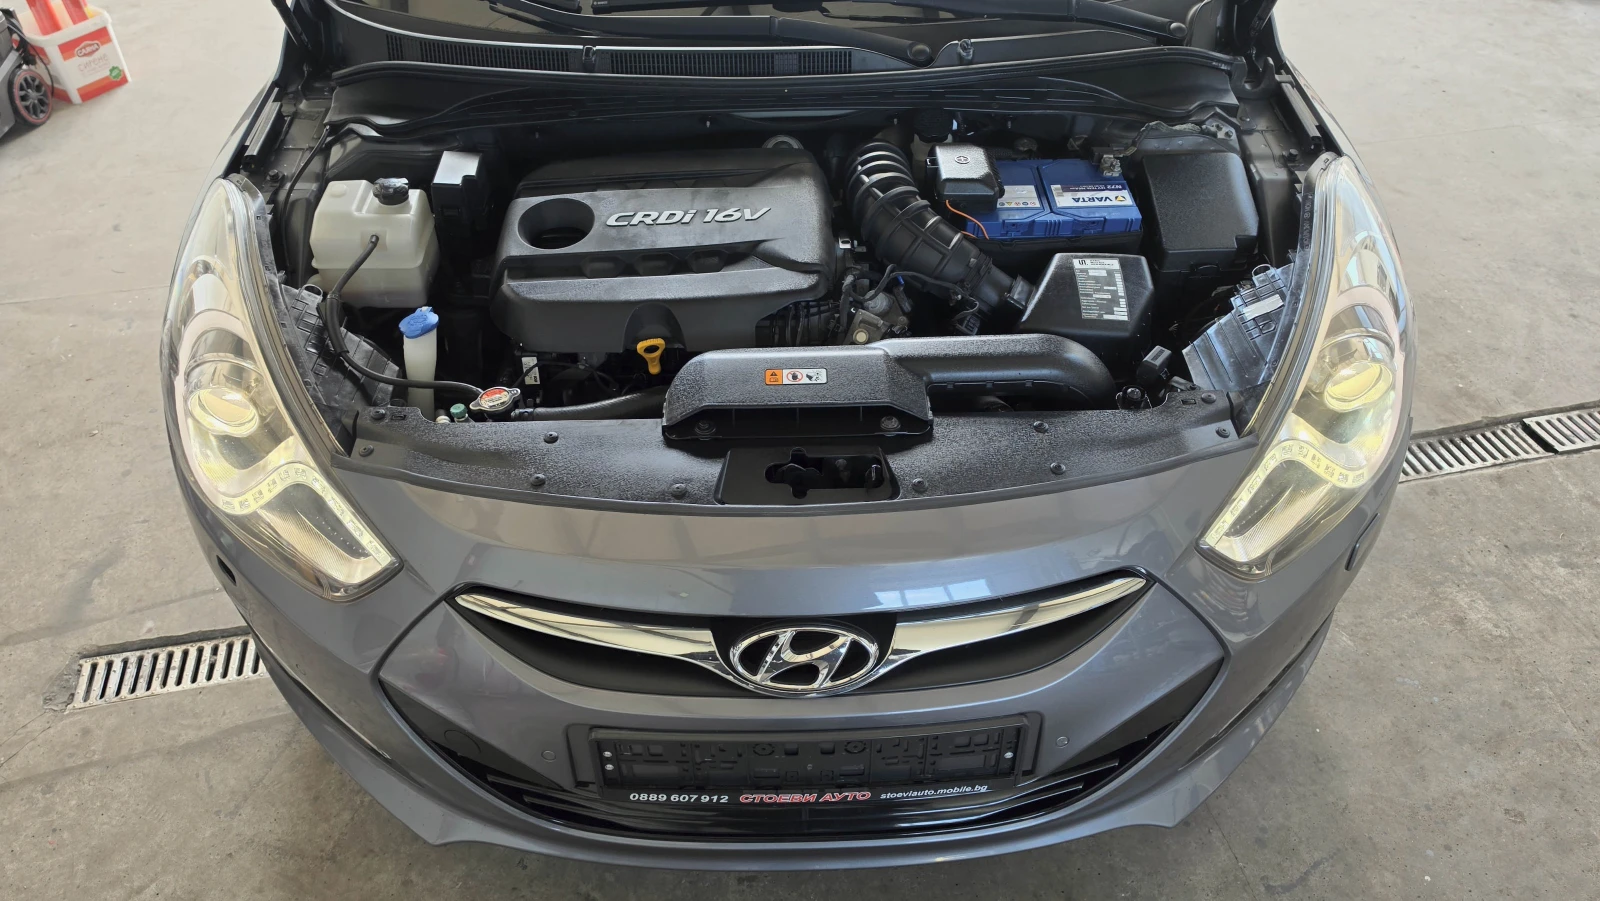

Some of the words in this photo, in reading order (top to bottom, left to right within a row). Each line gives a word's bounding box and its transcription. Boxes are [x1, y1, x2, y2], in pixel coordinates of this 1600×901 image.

[606, 209, 698, 227] CRDi
[703, 207, 771, 223] 16V
[629, 793, 667, 801] 0889
[670, 794, 698, 802] 607
[700, 795, 729, 803] 912
[739, 793, 817, 803] СТОЕВИ
[819, 791, 871, 801] АУТО
[880, 785, 988, 799] stoeviauto.mobile.bg
